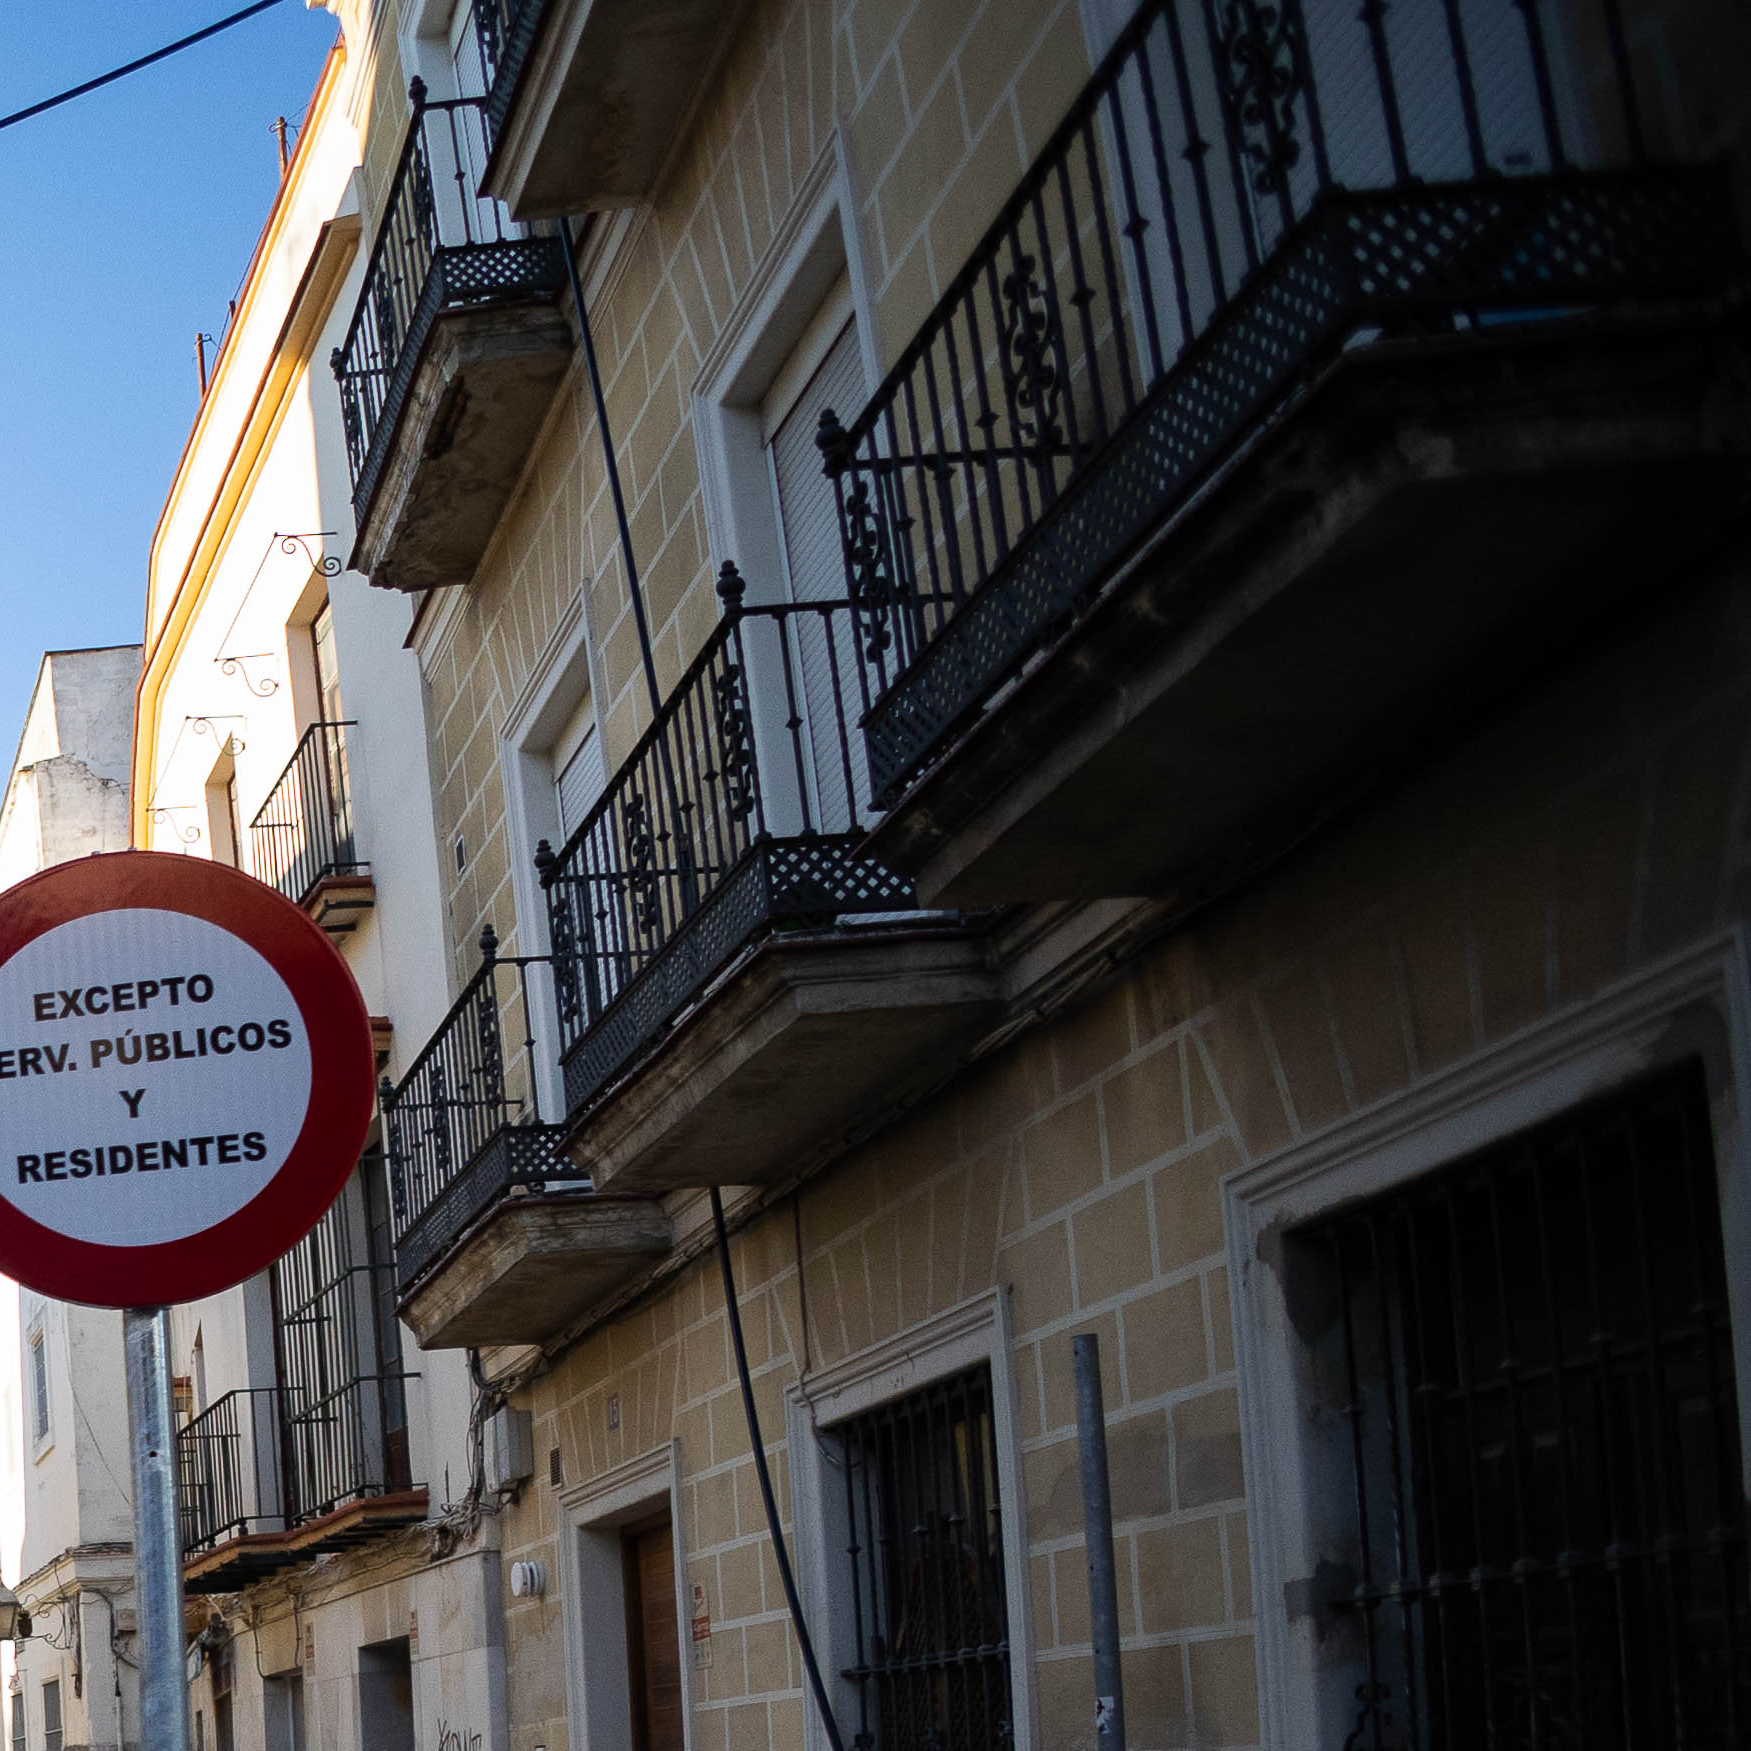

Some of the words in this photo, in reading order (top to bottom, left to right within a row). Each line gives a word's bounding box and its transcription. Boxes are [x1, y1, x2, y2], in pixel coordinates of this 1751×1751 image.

[33, 974, 214, 1022] EXCEPTO
[91, 1019, 293, 1069] PÚBLICOS
[118, 1088, 146, 1118] Y
[17, 1132, 267, 1184] RESIDENTES
